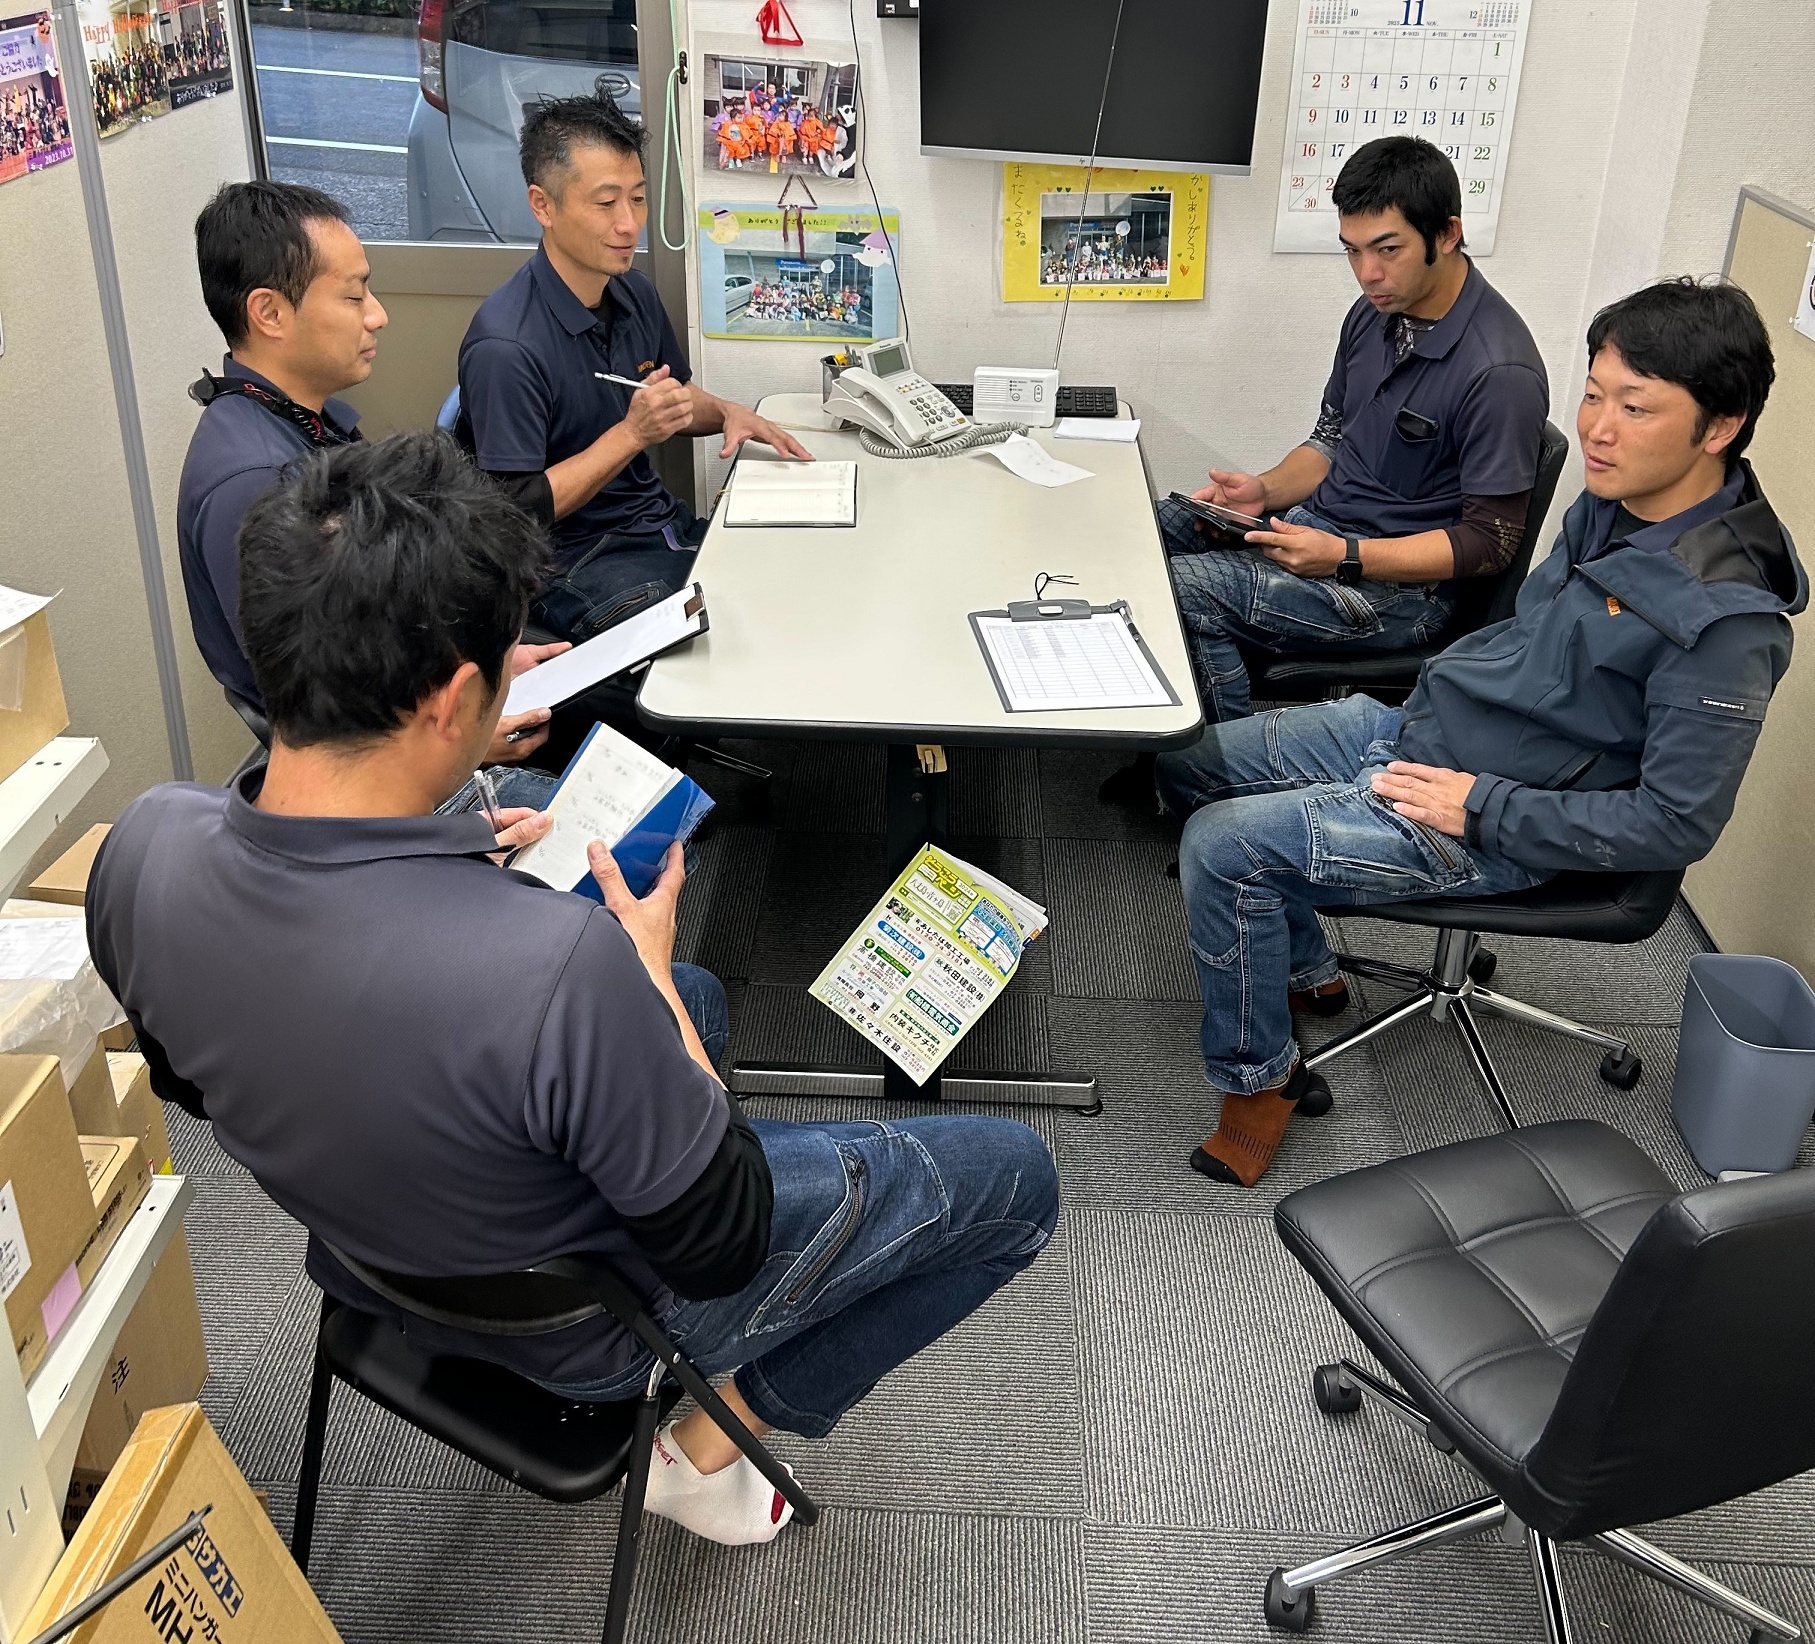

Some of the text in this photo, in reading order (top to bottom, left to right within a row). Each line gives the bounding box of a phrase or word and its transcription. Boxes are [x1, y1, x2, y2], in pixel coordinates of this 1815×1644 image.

[1350, 8, 1358, 16] 10
[1400, 0, 1424, 26] 11
[1470, 10, 1478, 19] 12
[1494, 42, 1500, 56] 1
[1312, 74, 1497, 91] 2 3 4 5 6 7 8
[1308, 108, 1495, 126] 9 10 11 12 13 14 15
[1302, 143, 1316, 157] 16
[1331, 144, 1345, 157] 17
[1474, 146, 1490, 160] 22
[1292, 177, 1485, 194] 23 2 29
[1012, 165, 1026, 241] またくるね
[1305, 198, 1316, 208] 30
[889, 1012, 931, 1048] 内装キクチ
